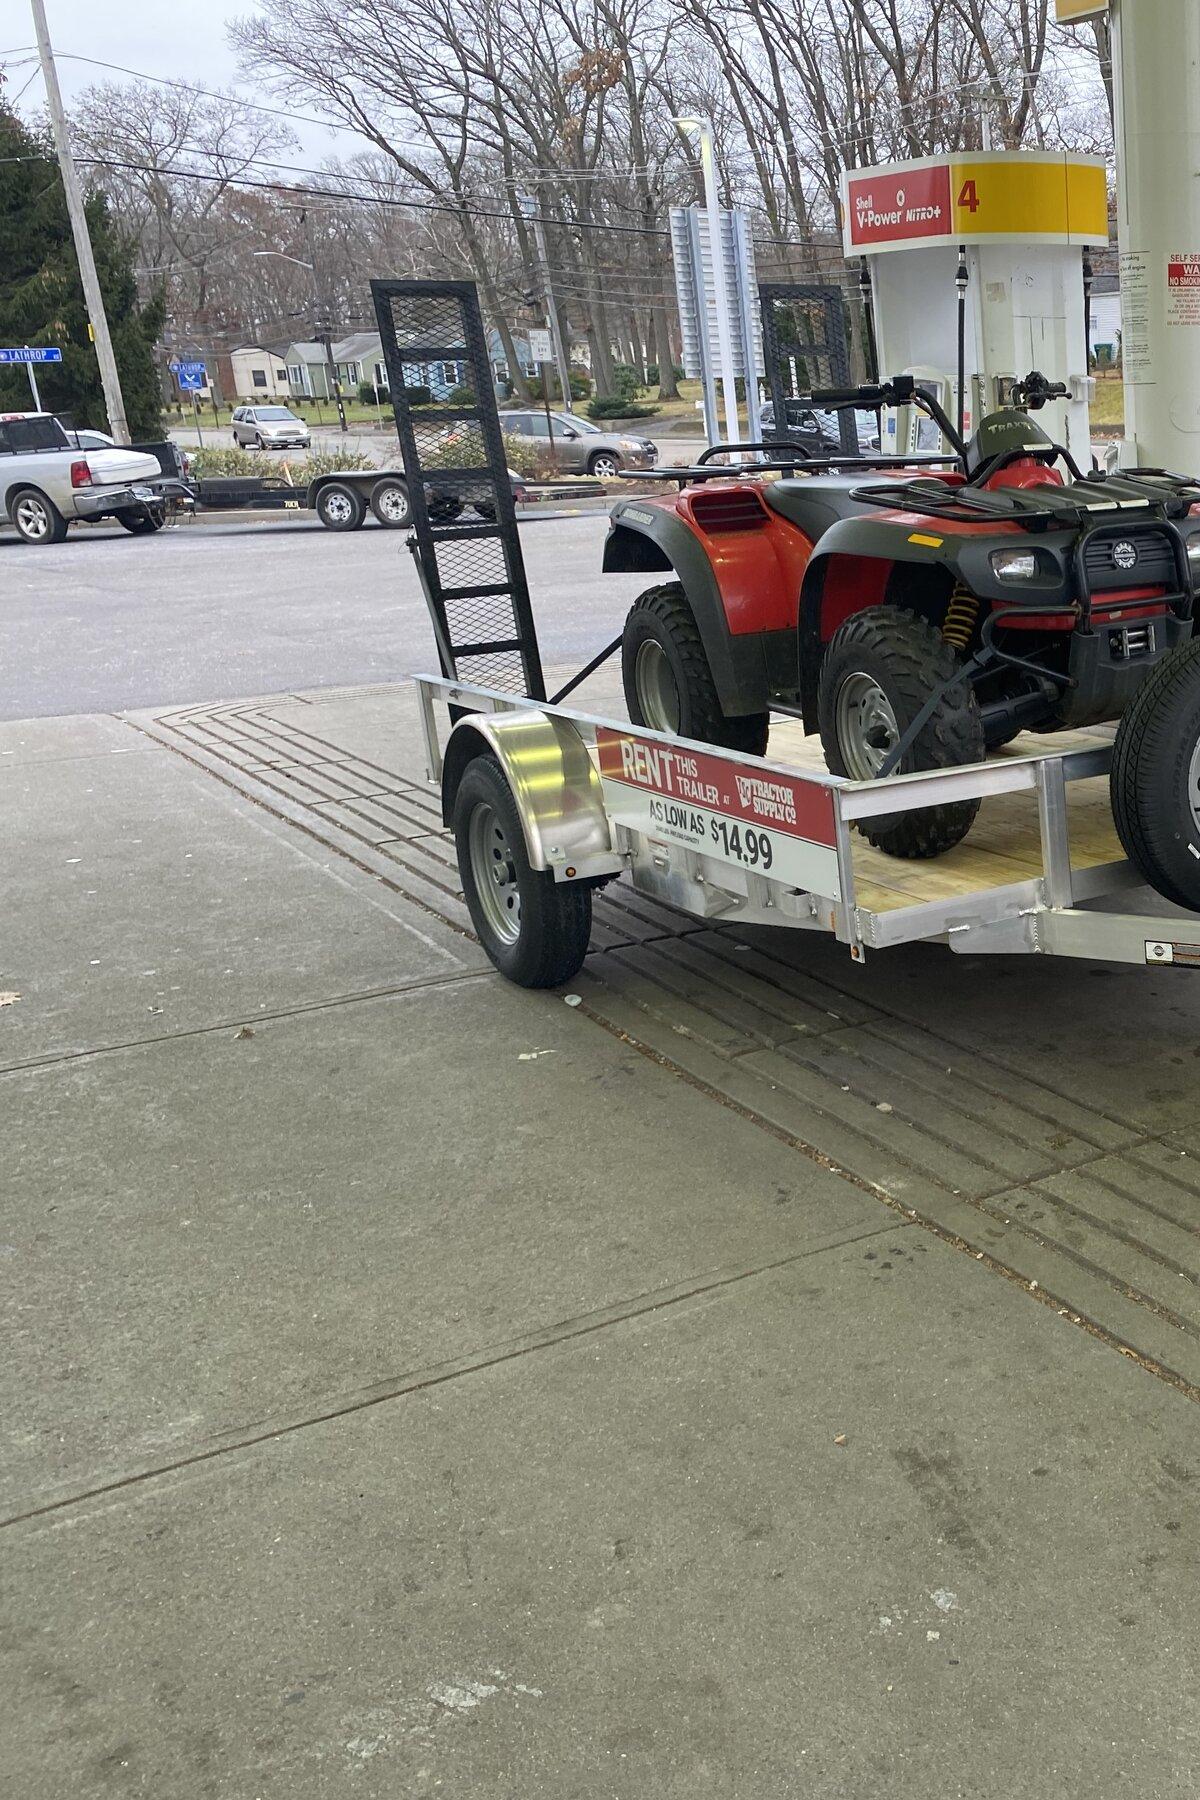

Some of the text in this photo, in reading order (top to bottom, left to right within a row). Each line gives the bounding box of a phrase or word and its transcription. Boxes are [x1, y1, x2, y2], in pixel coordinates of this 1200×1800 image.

[856, 195, 872, 210] Shell
[957, 180, 980, 213] 4
[857, 210, 902, 229] V-Power
[1170, 254, 1188, 262] SELF
[1169, 277, 1179, 286] NO
[9, 350, 47, 360] LATHROP
[620, 740, 698, 791] RENT THIS
[676, 775, 730, 806] TRAILER AT
[751, 778, 795, 806] TRACTOR
[753, 796, 785, 822] SUPPLY
[649, 800, 663, 822] AS
[664, 803, 687, 830] LOW
[690, 812, 705, 836] AS
[711, 817, 773, 869] $14.99
